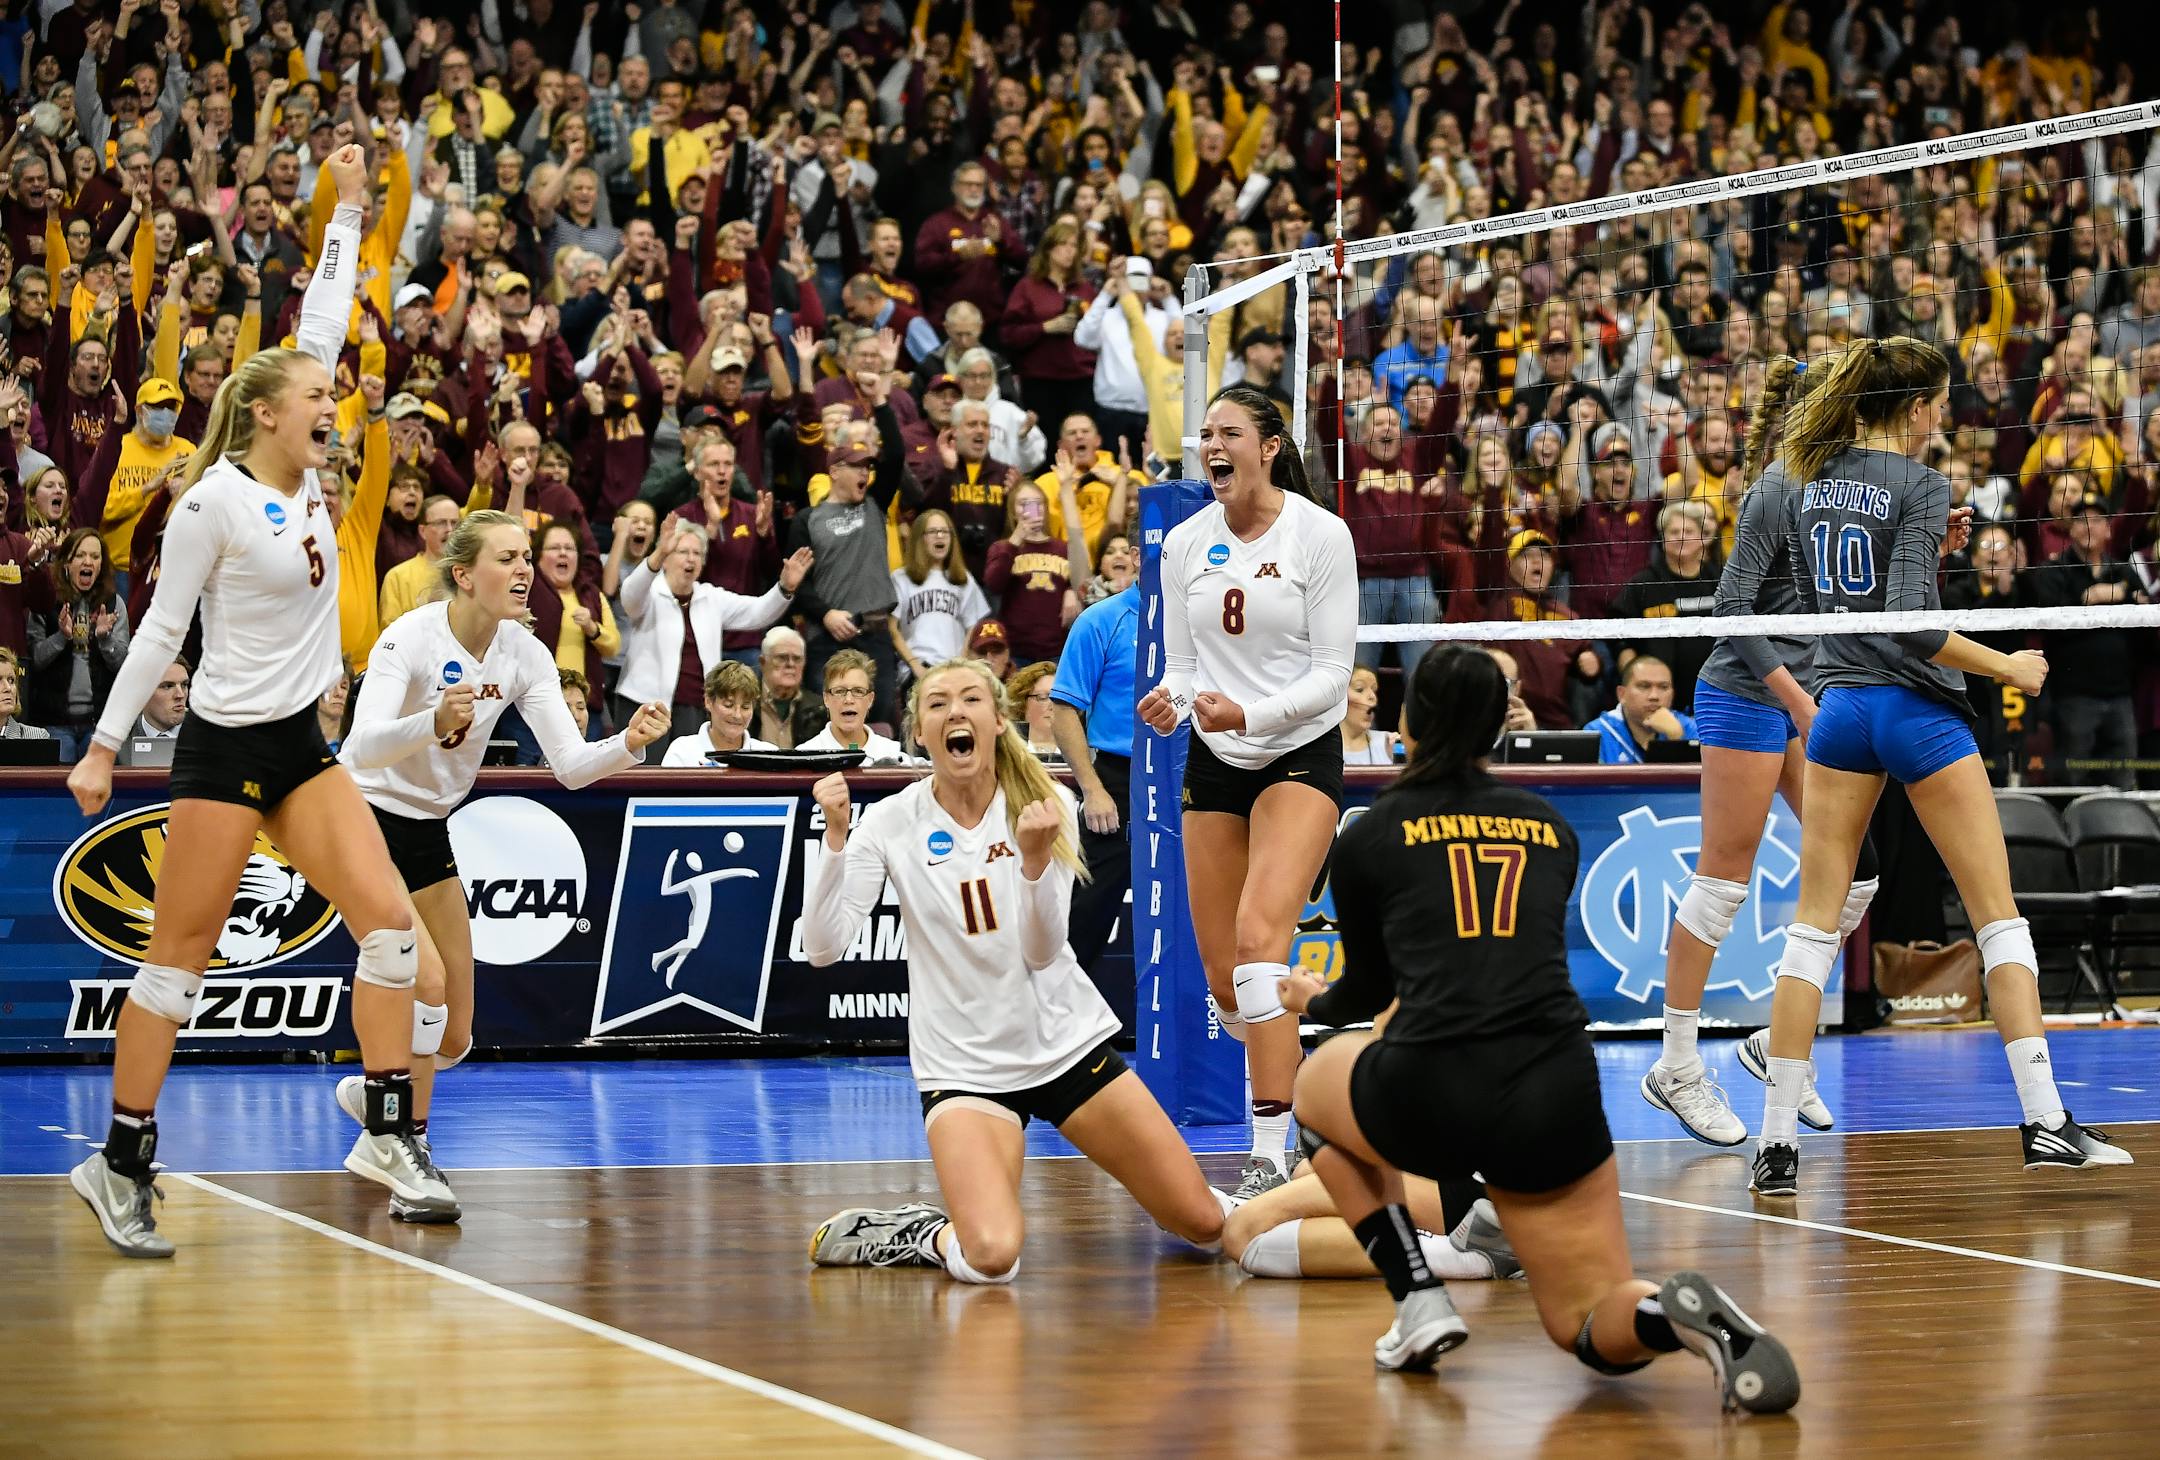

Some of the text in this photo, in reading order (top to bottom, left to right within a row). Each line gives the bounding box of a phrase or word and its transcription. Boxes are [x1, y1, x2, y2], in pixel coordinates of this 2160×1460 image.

[2035, 123, 2058, 138] NCAA
[2059, 118, 2096, 133] VOLLEYBALL
[2095, 108, 2142, 126] CHAMPIONSHIP
[1926, 129, 2026, 156] NCAA VOLLEYBALL CHAMPIONSHIP
[1824, 147, 1918, 174] NCAA VOLLEYBALL CHAMPIONSHIP
[1637, 193, 1654, 206] NCAA
[1728, 178, 1747, 190] NCAA
[1471, 222, 1487, 234] NCAA
[1551, 208, 1569, 221] NCAA
[1396, 235, 1412, 247] NCAA
[323, 239, 340, 280] GOLDEN
[1801, 479, 1891, 521] BRUINS
[1145, 528, 1163, 545] NCAA
[302, 533, 325, 588] 5
[1254, 562, 1281, 579] M
[1810, 520, 1877, 596] 10
[1222, 588, 1246, 636] 8
[1145, 594, 1162, 1060] VOLEYBALL
[1402, 814, 1561, 849] MINNESOTA
[985, 840, 1015, 864] M
[467, 878, 579, 919] NCAA
[960, 876, 999, 937] 11
[1447, 842, 1528, 939] 17
[70, 981, 338, 1034] MZOU
